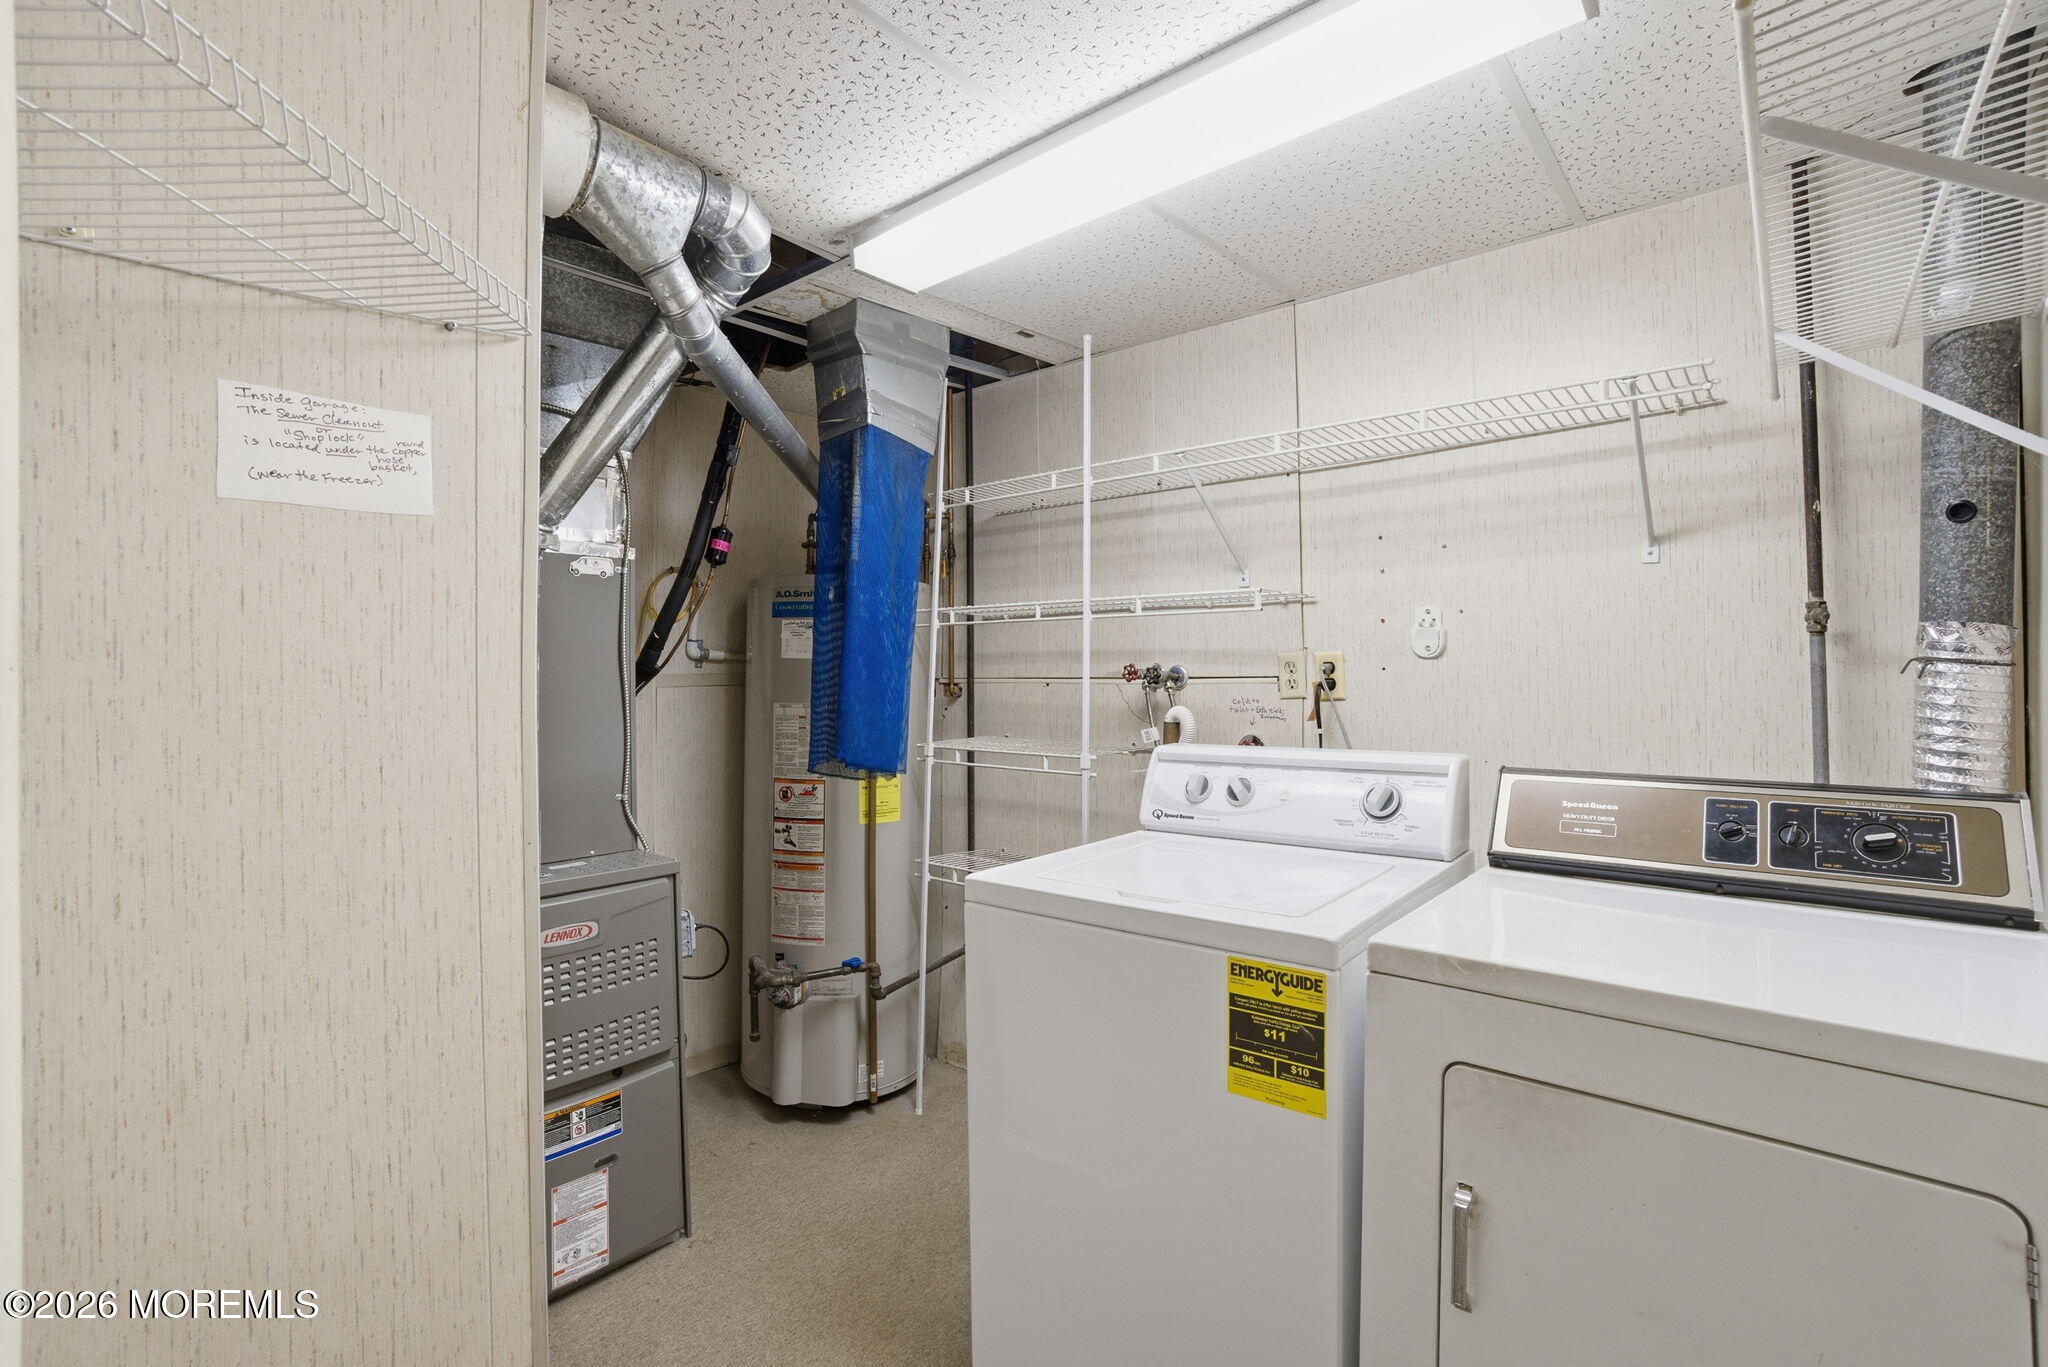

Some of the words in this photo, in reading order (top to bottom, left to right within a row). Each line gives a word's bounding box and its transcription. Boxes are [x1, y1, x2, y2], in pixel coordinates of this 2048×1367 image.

[234, 386, 294, 405] Inside
[301, 396, 366, 414] garage:
[237, 405, 271, 416] The
[277, 408, 319, 422] Sewer
[316, 426, 332, 434] or
[244, 435, 259, 446] is
[270, 438, 320, 453] located
[325, 444, 362, 455] under
[366, 444, 389, 455] the
[392, 447, 427, 457] copper
[376, 455, 404, 464] hose
[297, 469, 319, 482] the
[543, 926, 584, 944] LENNOX
[1230, 962, 1323, 994] ENERGYGUIDE
[1263, 1028, 1286, 1042] $11
[1242, 1054, 1255, 1064] 96
[1290, 1065, 1310, 1077] $10
